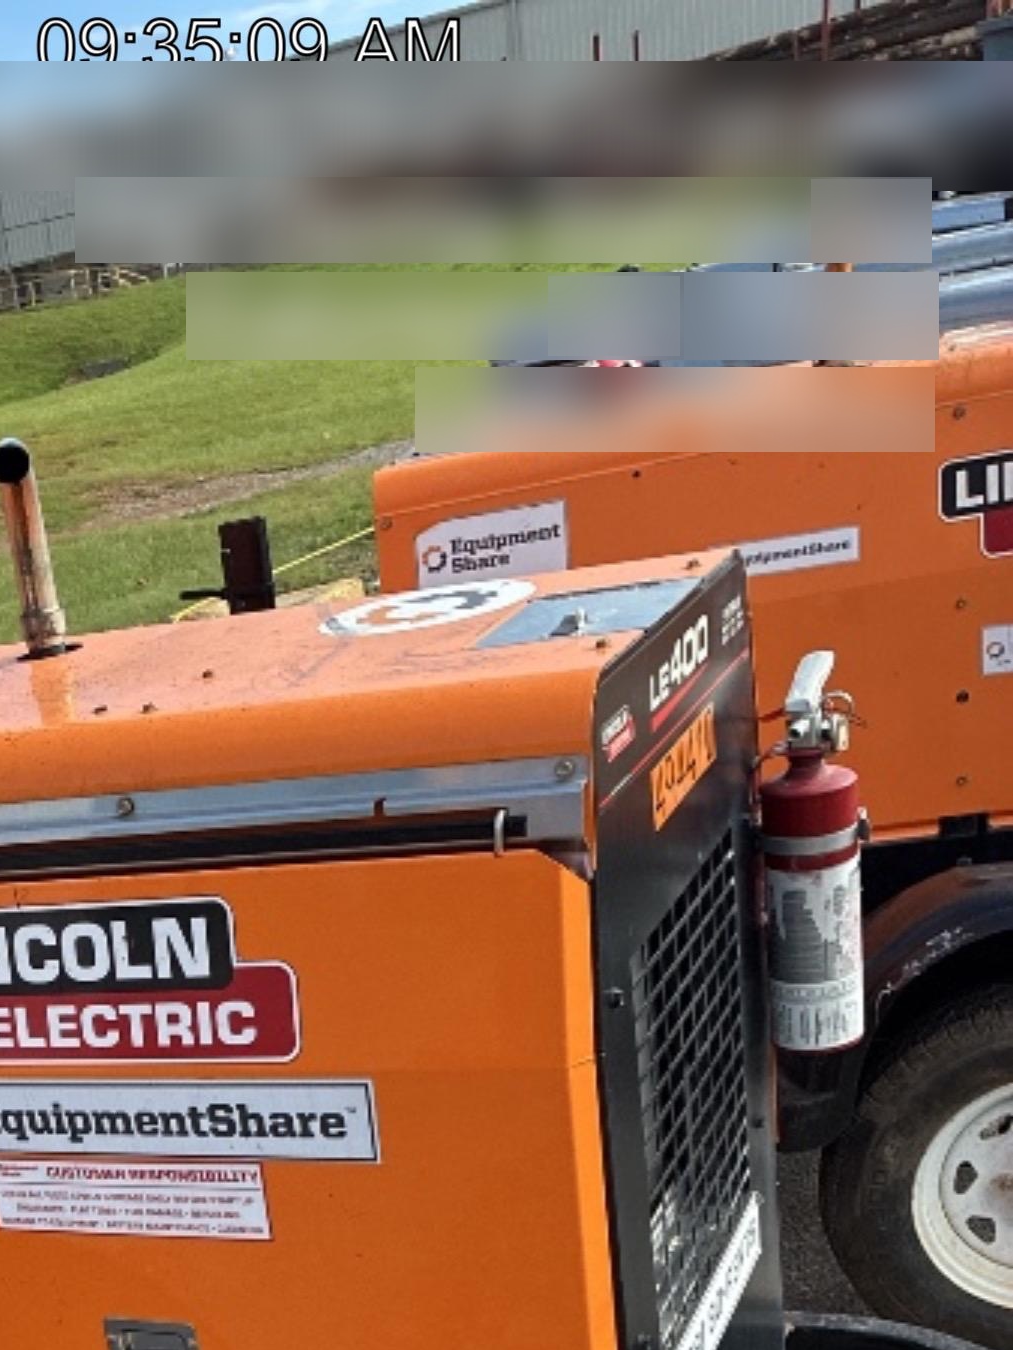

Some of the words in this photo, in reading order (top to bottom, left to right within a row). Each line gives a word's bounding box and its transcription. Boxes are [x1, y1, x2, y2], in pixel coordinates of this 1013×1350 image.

[449, 523, 561, 555] Equipment
[451, 552, 510, 574] Share
[649, 613, 709, 712] LE400
